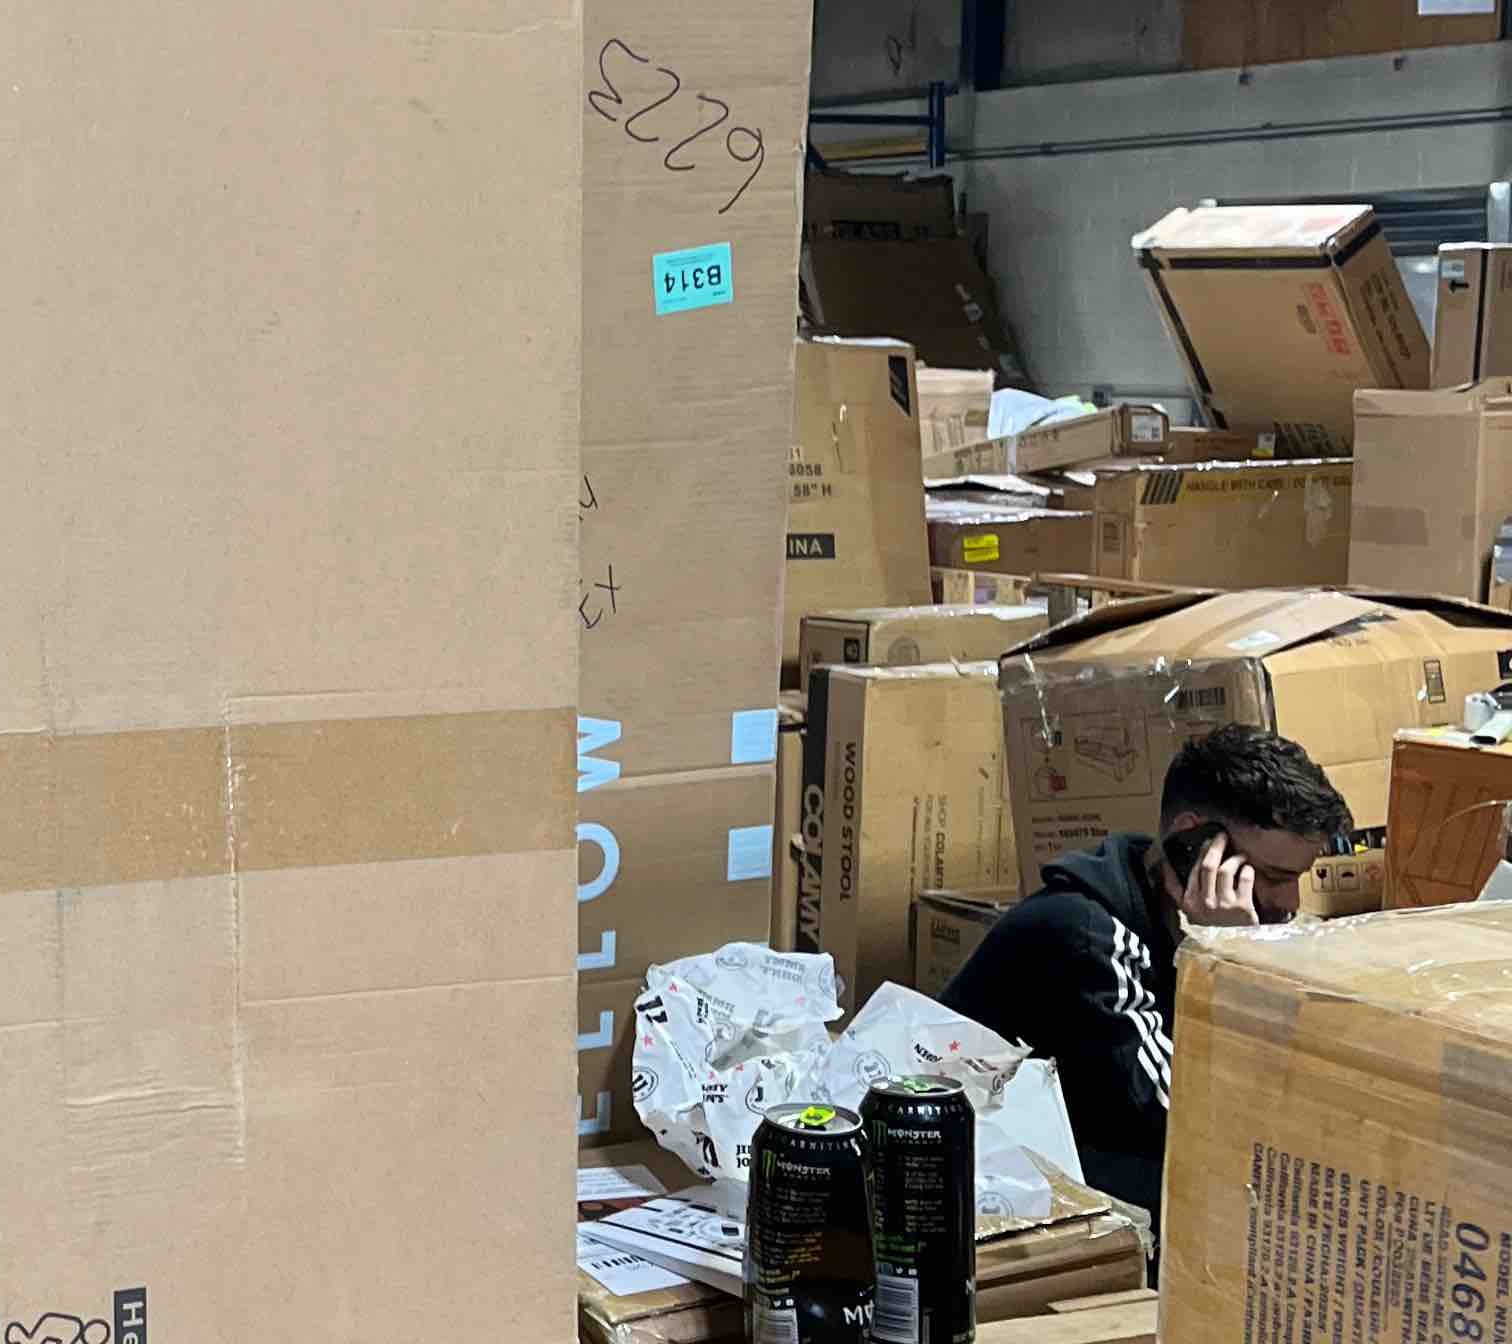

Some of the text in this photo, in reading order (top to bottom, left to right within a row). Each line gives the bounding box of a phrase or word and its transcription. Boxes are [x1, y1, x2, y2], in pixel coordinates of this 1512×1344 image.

[664, 264, 722, 293] B314
[839, 741, 858, 904] WOOD STOOL
[887, 1127, 942, 1140] MONSTER
[776, 1159, 832, 1177] MONSTER
[1308, 1162, 1320, 1209] MADE
[1324, 1168, 1336, 1212] DATE
[1306, 1212, 1318, 1230] IN
[1358, 1179, 1370, 1220] UNIT
[1374, 1184, 1388, 1240] COLOR
[1406, 1196, 1420, 1242] CUNA
[1424, 1200, 1436, 1226] LIT
[1304, 1234, 1318, 1285] CHINA
[1334, 1232, 1348, 1296] WEIGHT
[1354, 1224, 1368, 1268] PACK
[1496, 1232, 1511, 1298] MODEL
